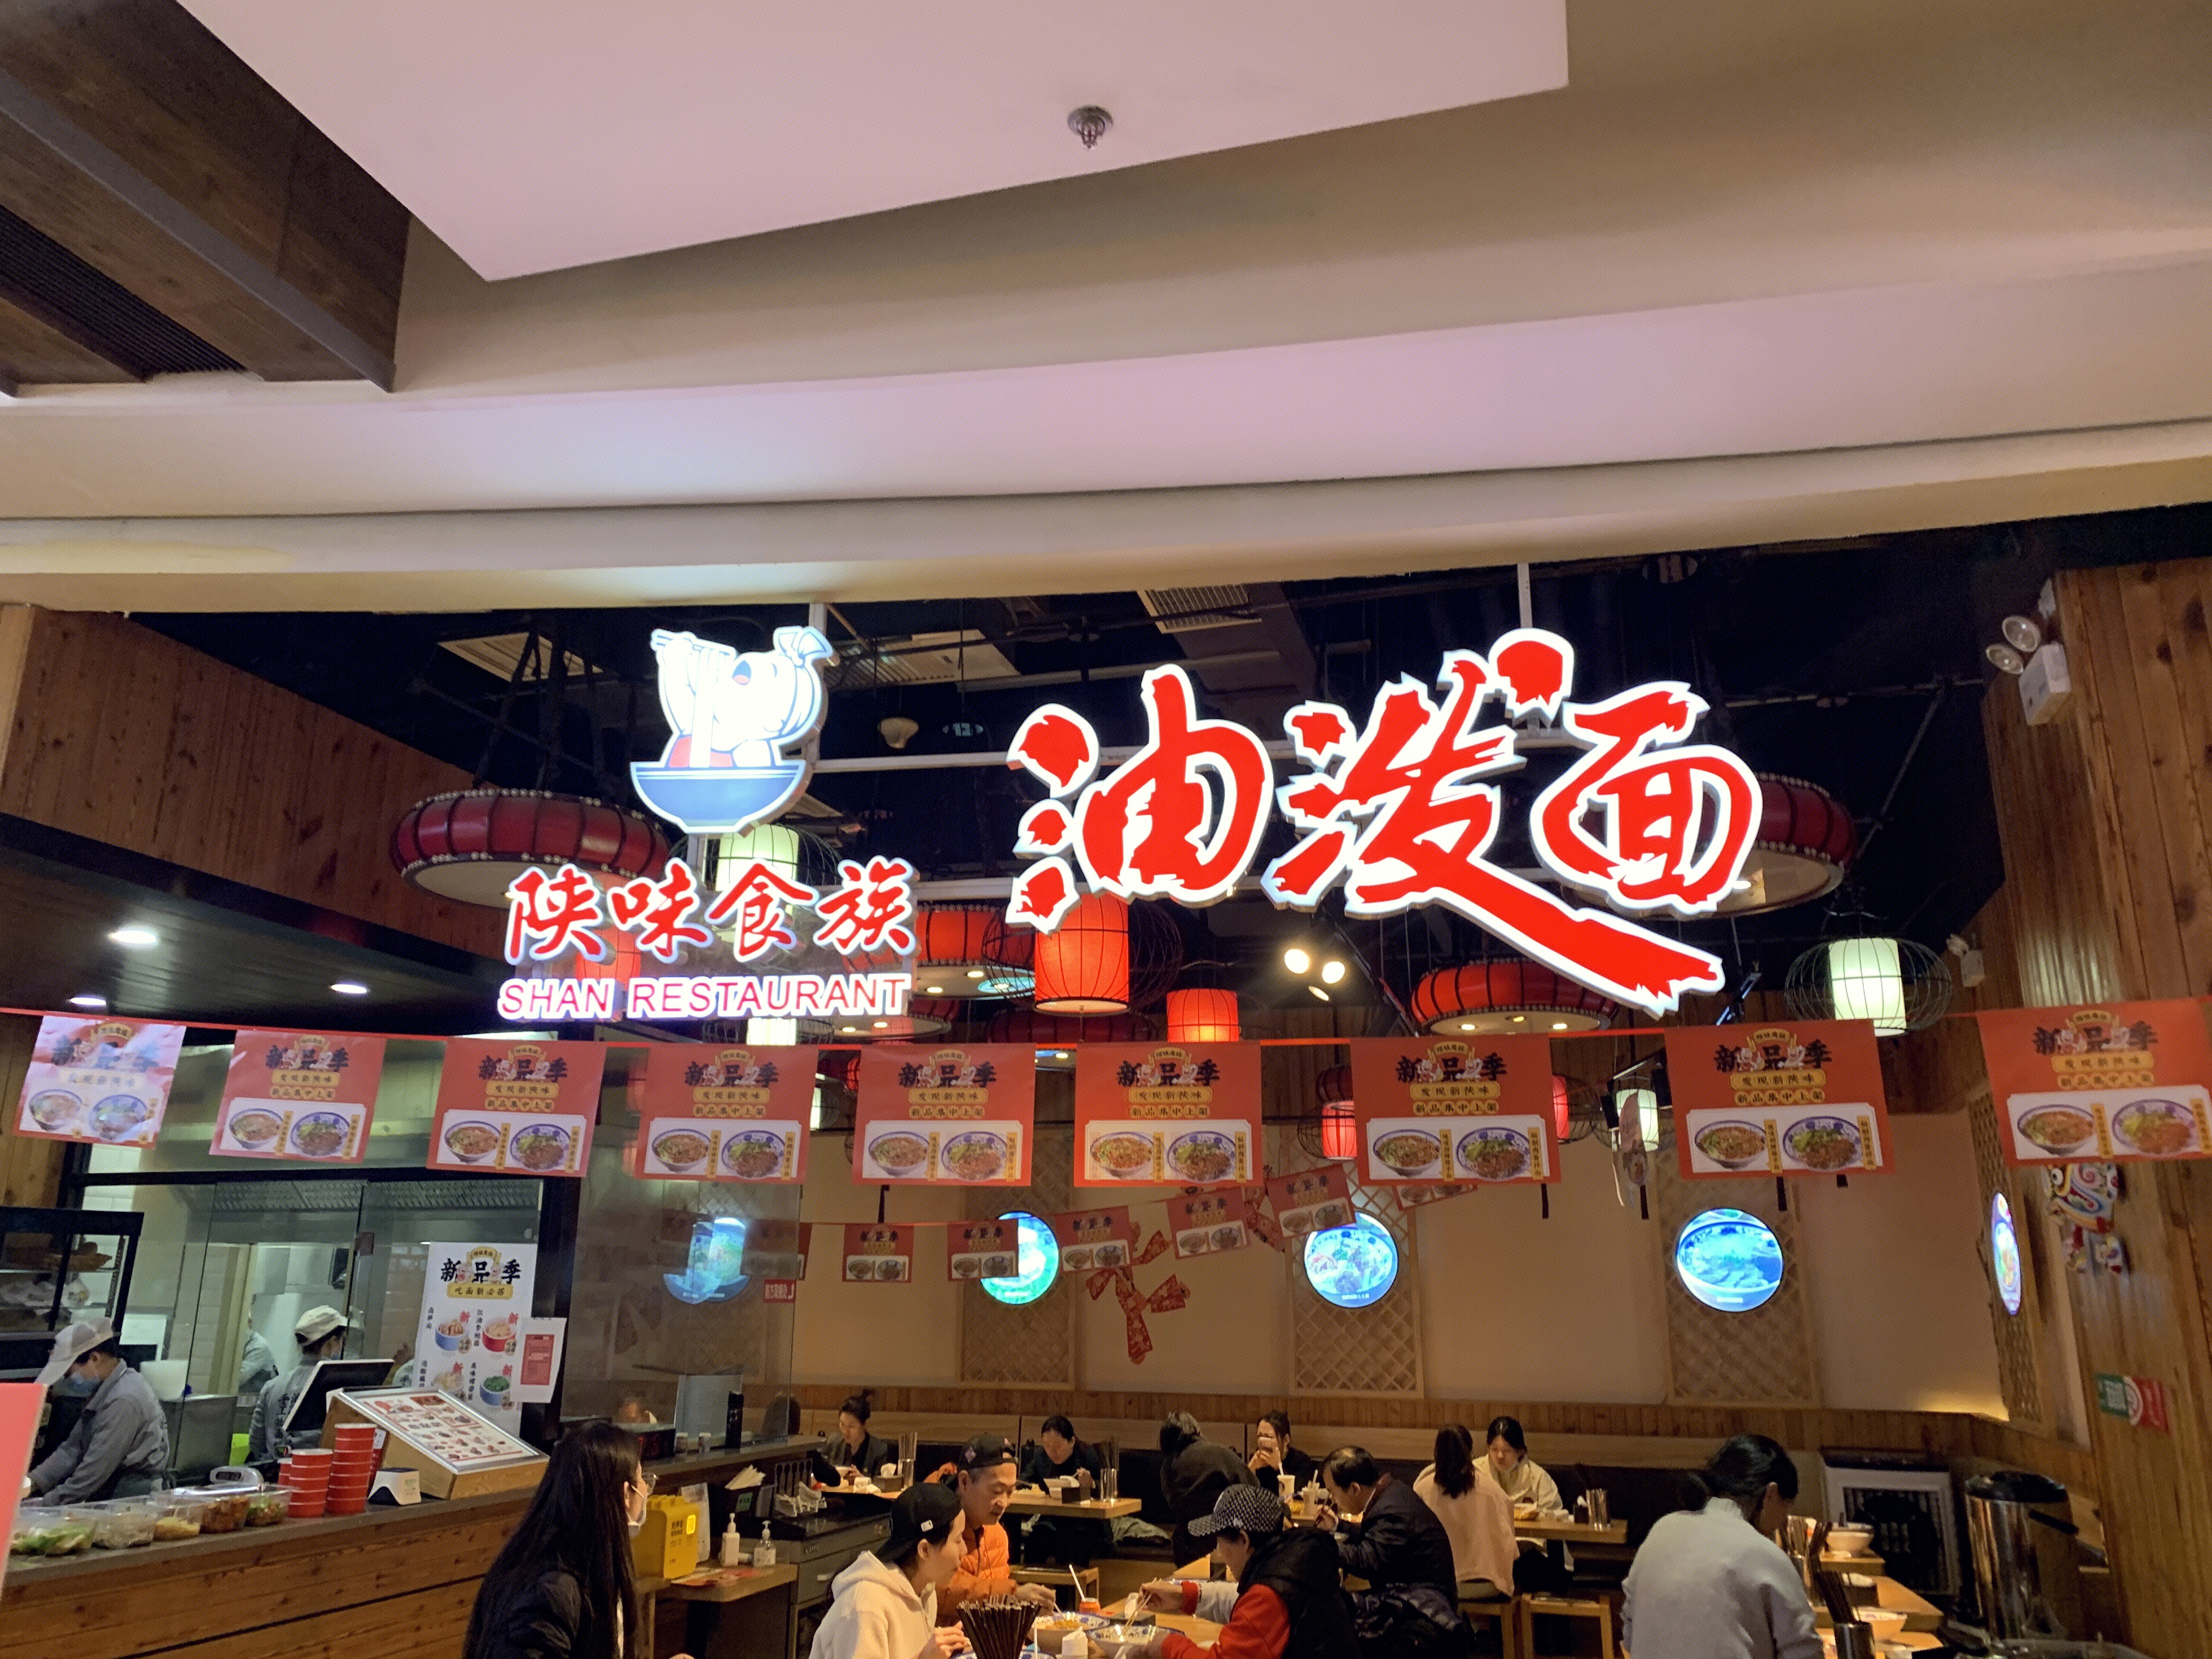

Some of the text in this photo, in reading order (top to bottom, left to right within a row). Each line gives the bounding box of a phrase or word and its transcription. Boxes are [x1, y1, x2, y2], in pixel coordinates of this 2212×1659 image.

[1012, 634, 1758, 1007] 油泼面
[507, 859, 913, 961] 陕味食族
[500, 977, 907, 1016] SHAN RESTAURANT
[441, 1258, 521, 1284] 新品季
